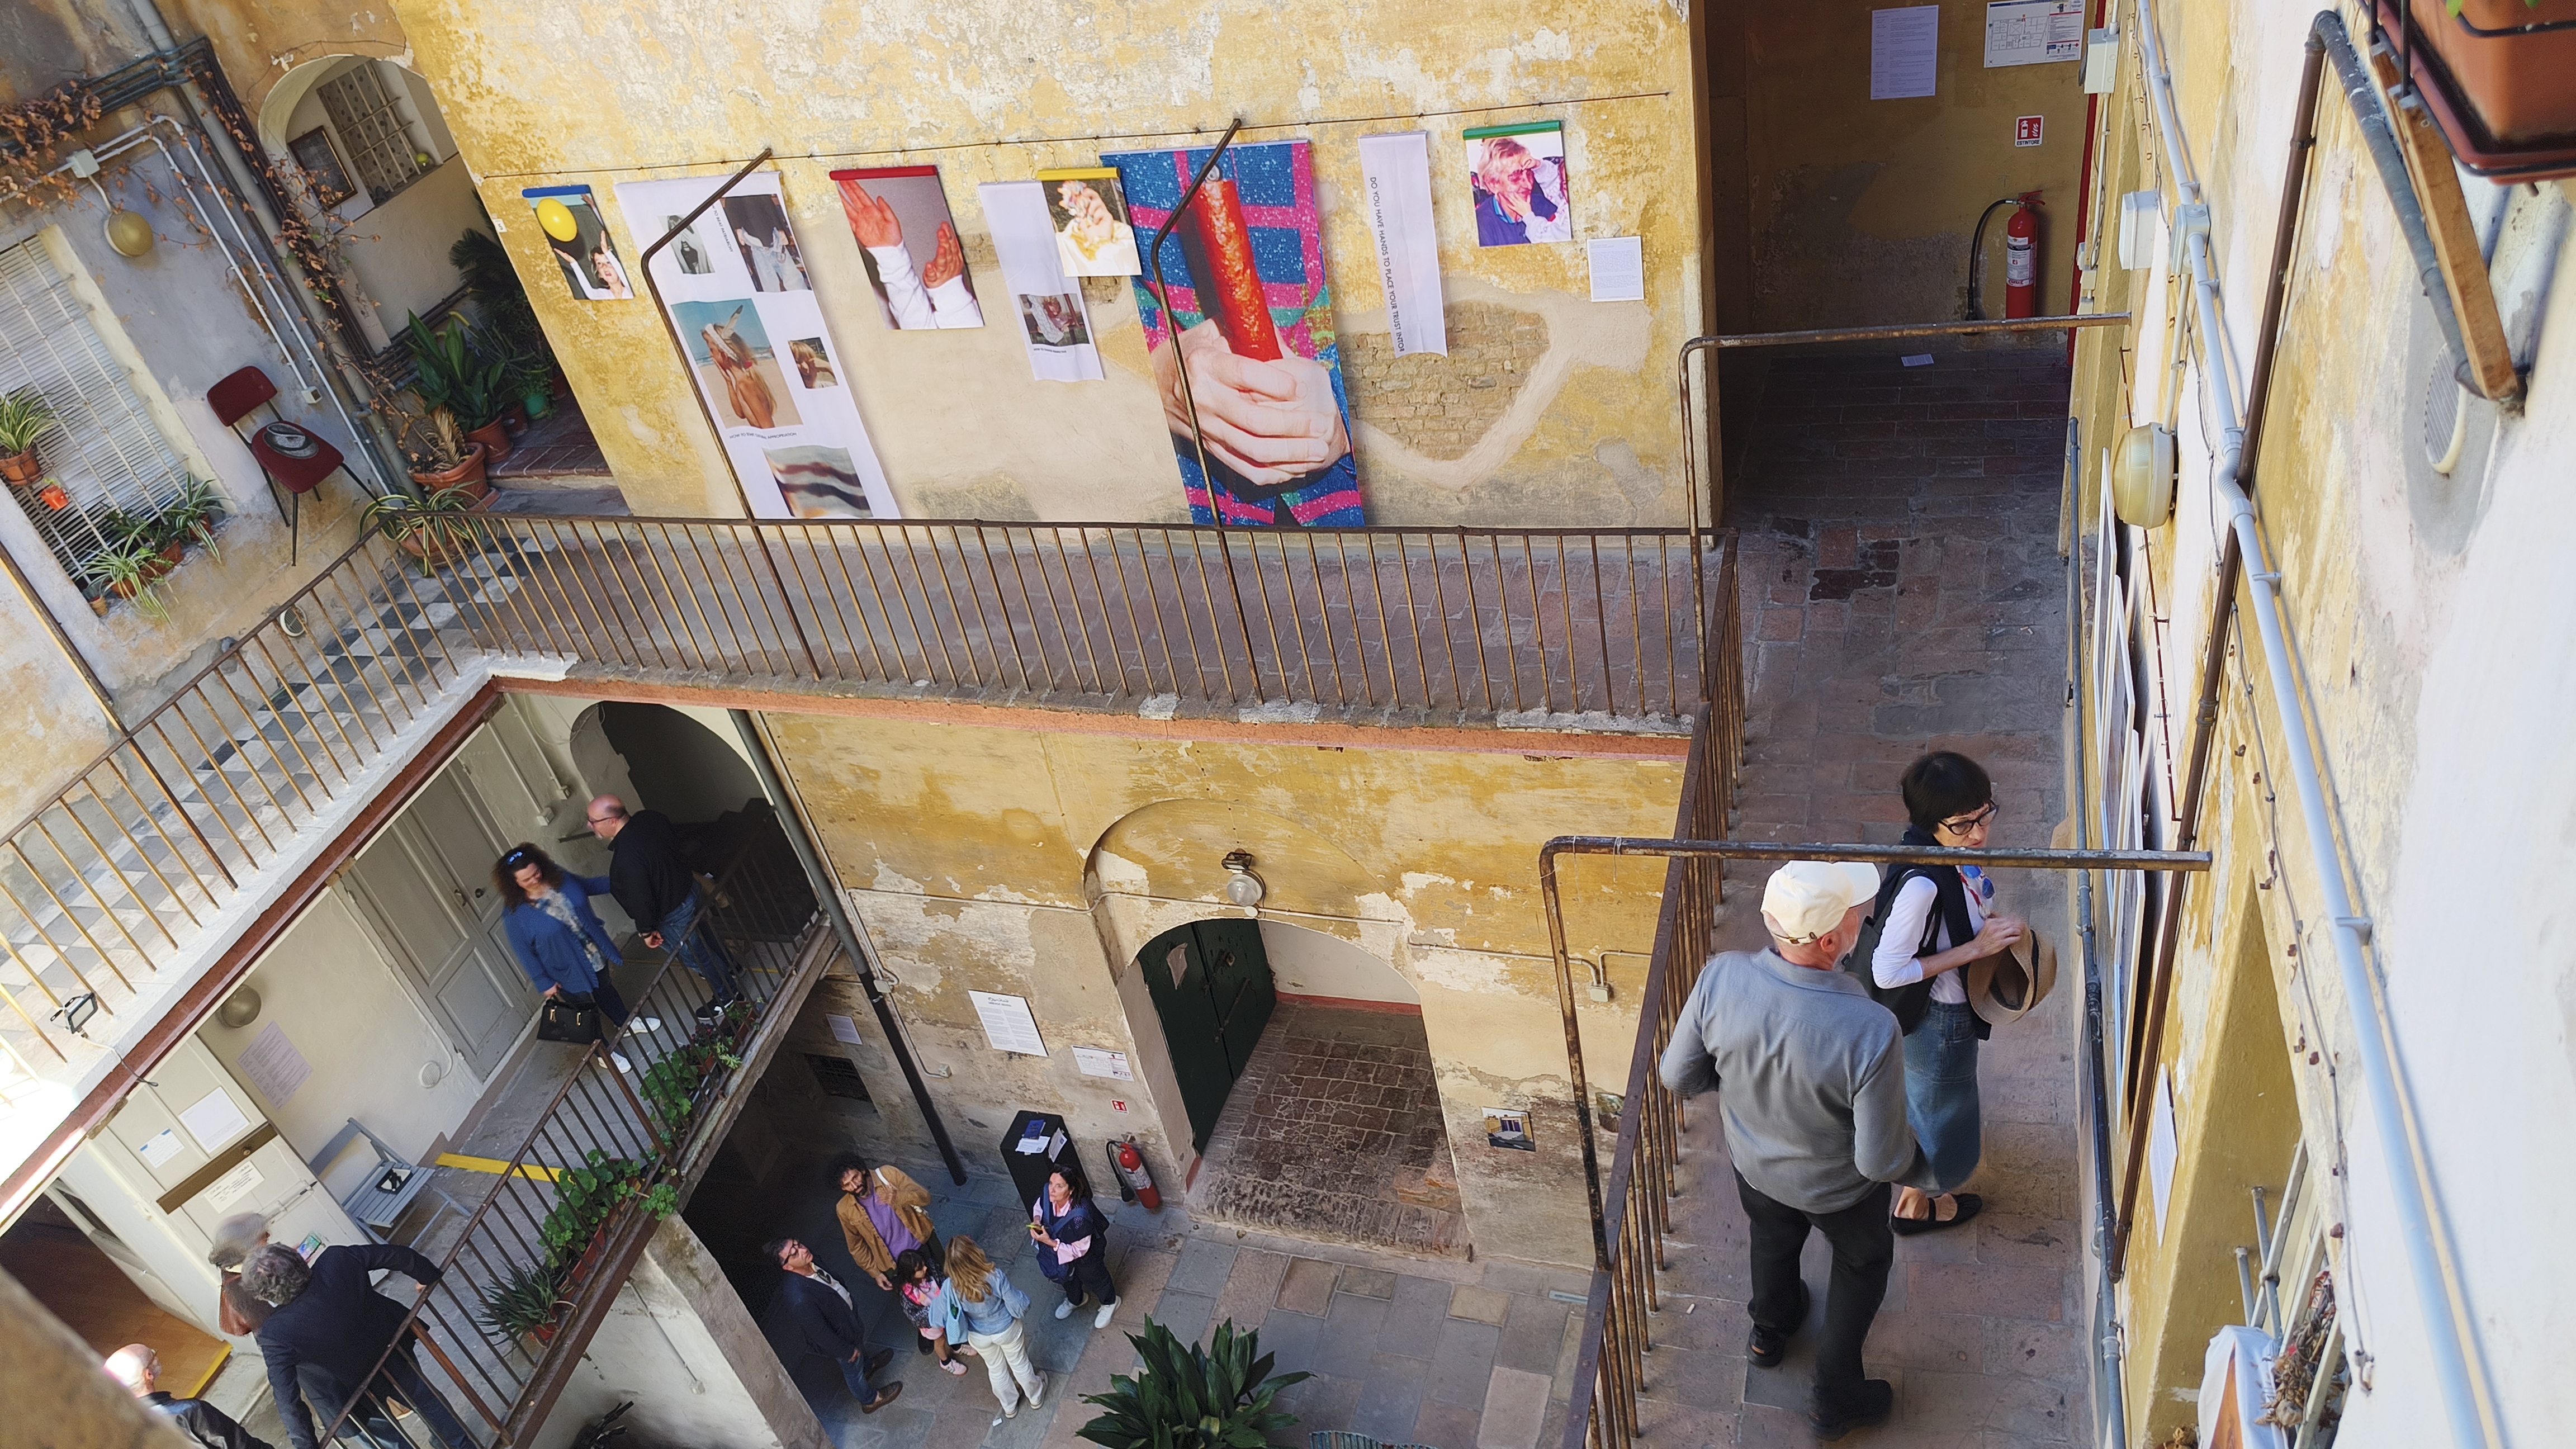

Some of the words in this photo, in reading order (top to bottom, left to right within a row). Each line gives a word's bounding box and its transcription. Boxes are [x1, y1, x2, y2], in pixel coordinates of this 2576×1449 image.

[1370, 177, 1377, 189] DO
[1376, 209, 1384, 229] HAVE
[1379, 230, 1388, 256] HANDS
[1384, 257, 1390, 267] TO
[1385, 268, 1394, 290] PLACE
[1389, 291, 1398, 310] YOUR
[1396, 332, 1405, 352] INTO?
